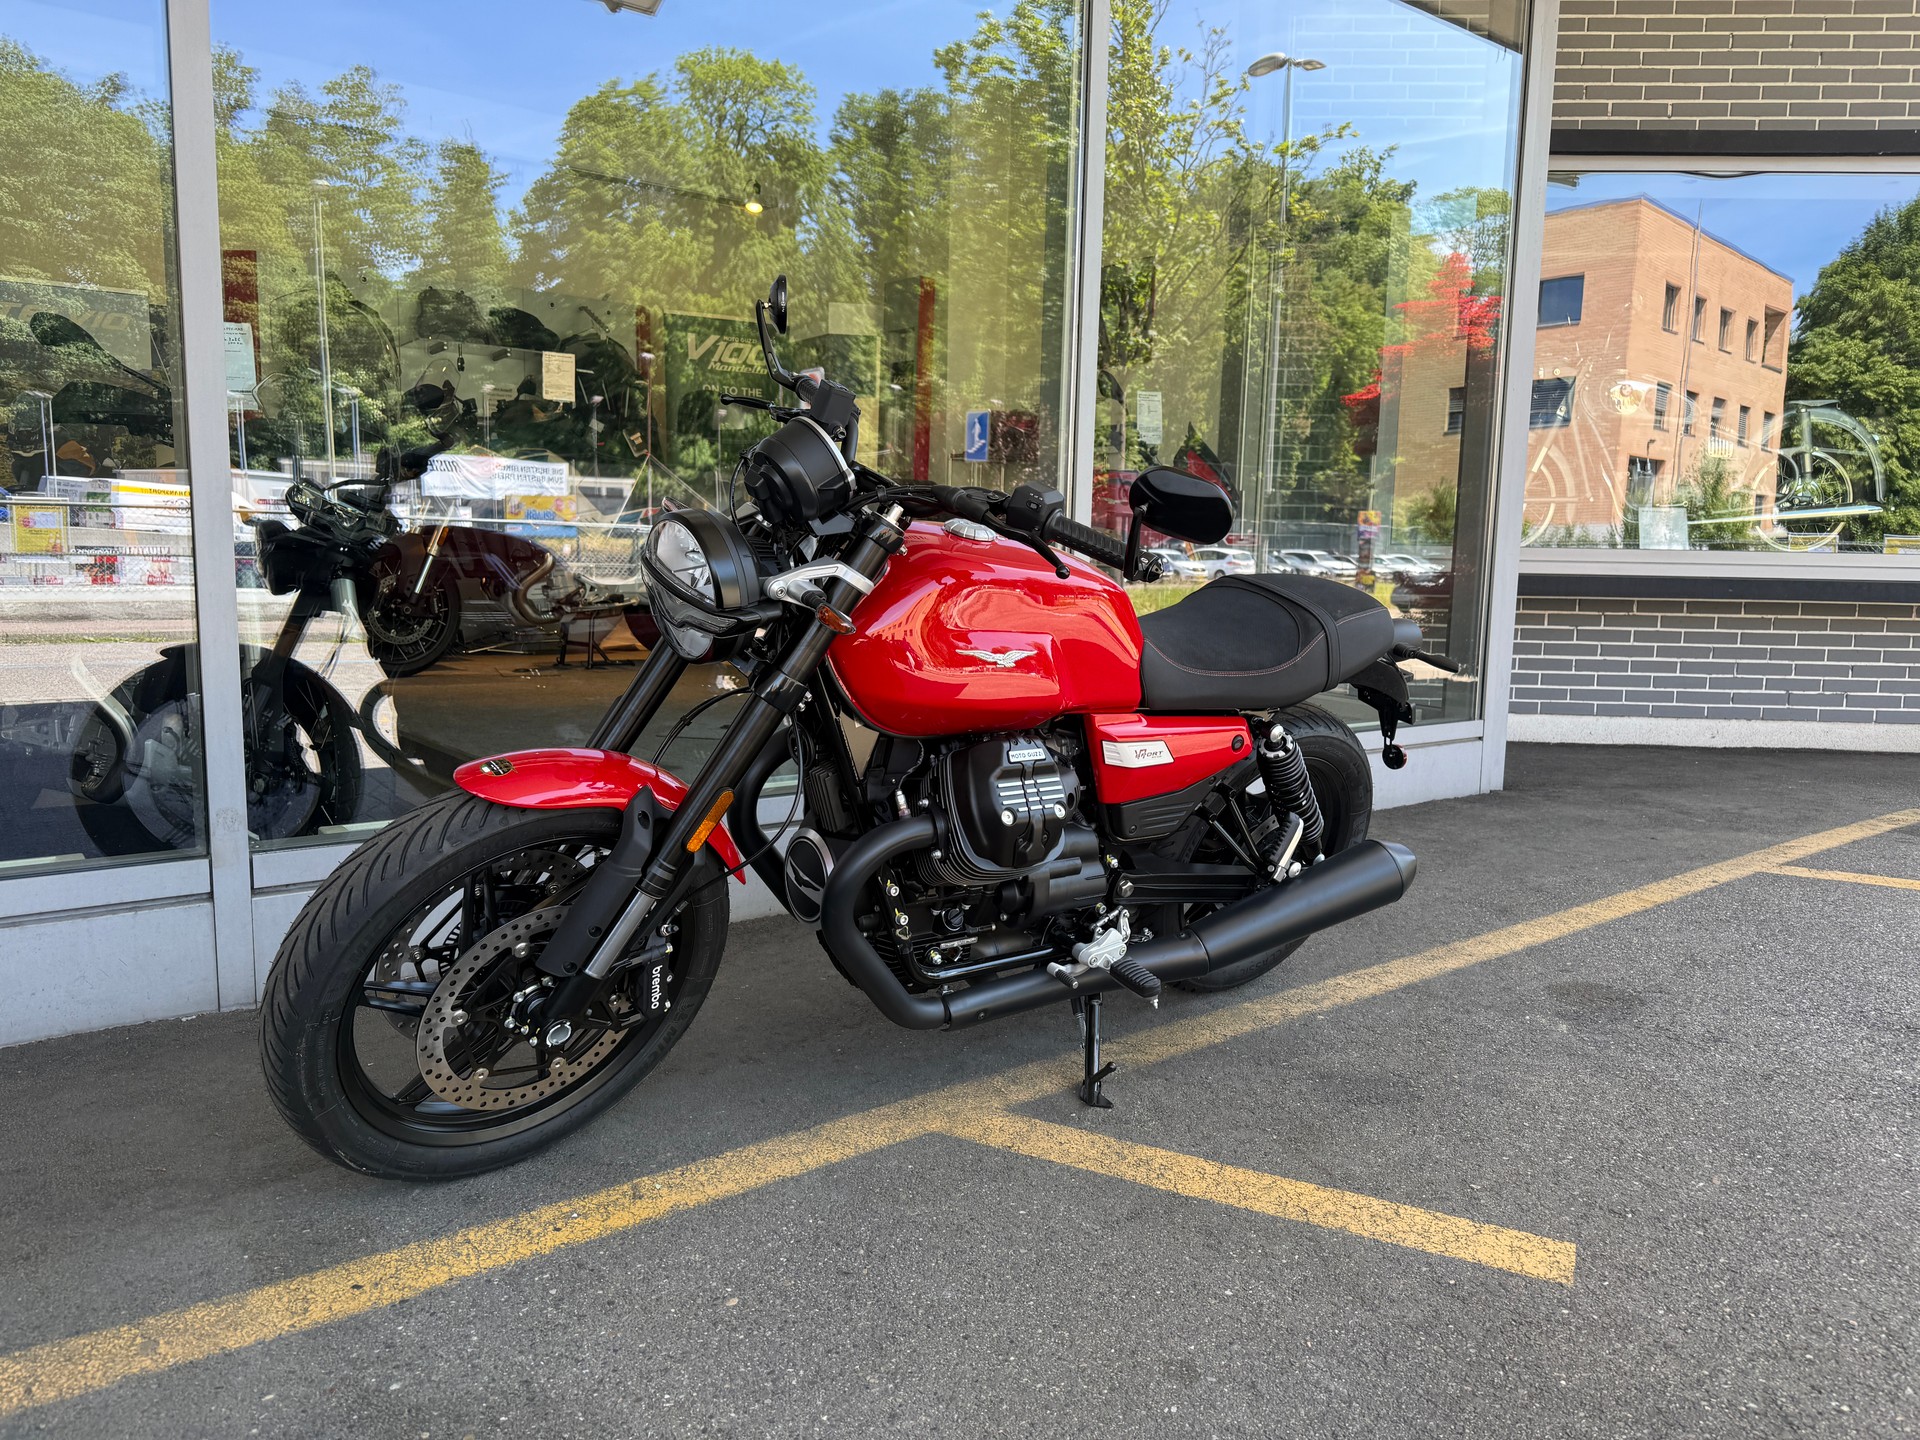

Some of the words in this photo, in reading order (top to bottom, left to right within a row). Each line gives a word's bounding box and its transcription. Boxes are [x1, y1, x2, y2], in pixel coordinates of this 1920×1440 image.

[723, 386, 738, 396] TO
[741, 387, 763, 398] THE
[1010, 752, 1027, 760] MOTO
[650, 964, 663, 1010] brembo
